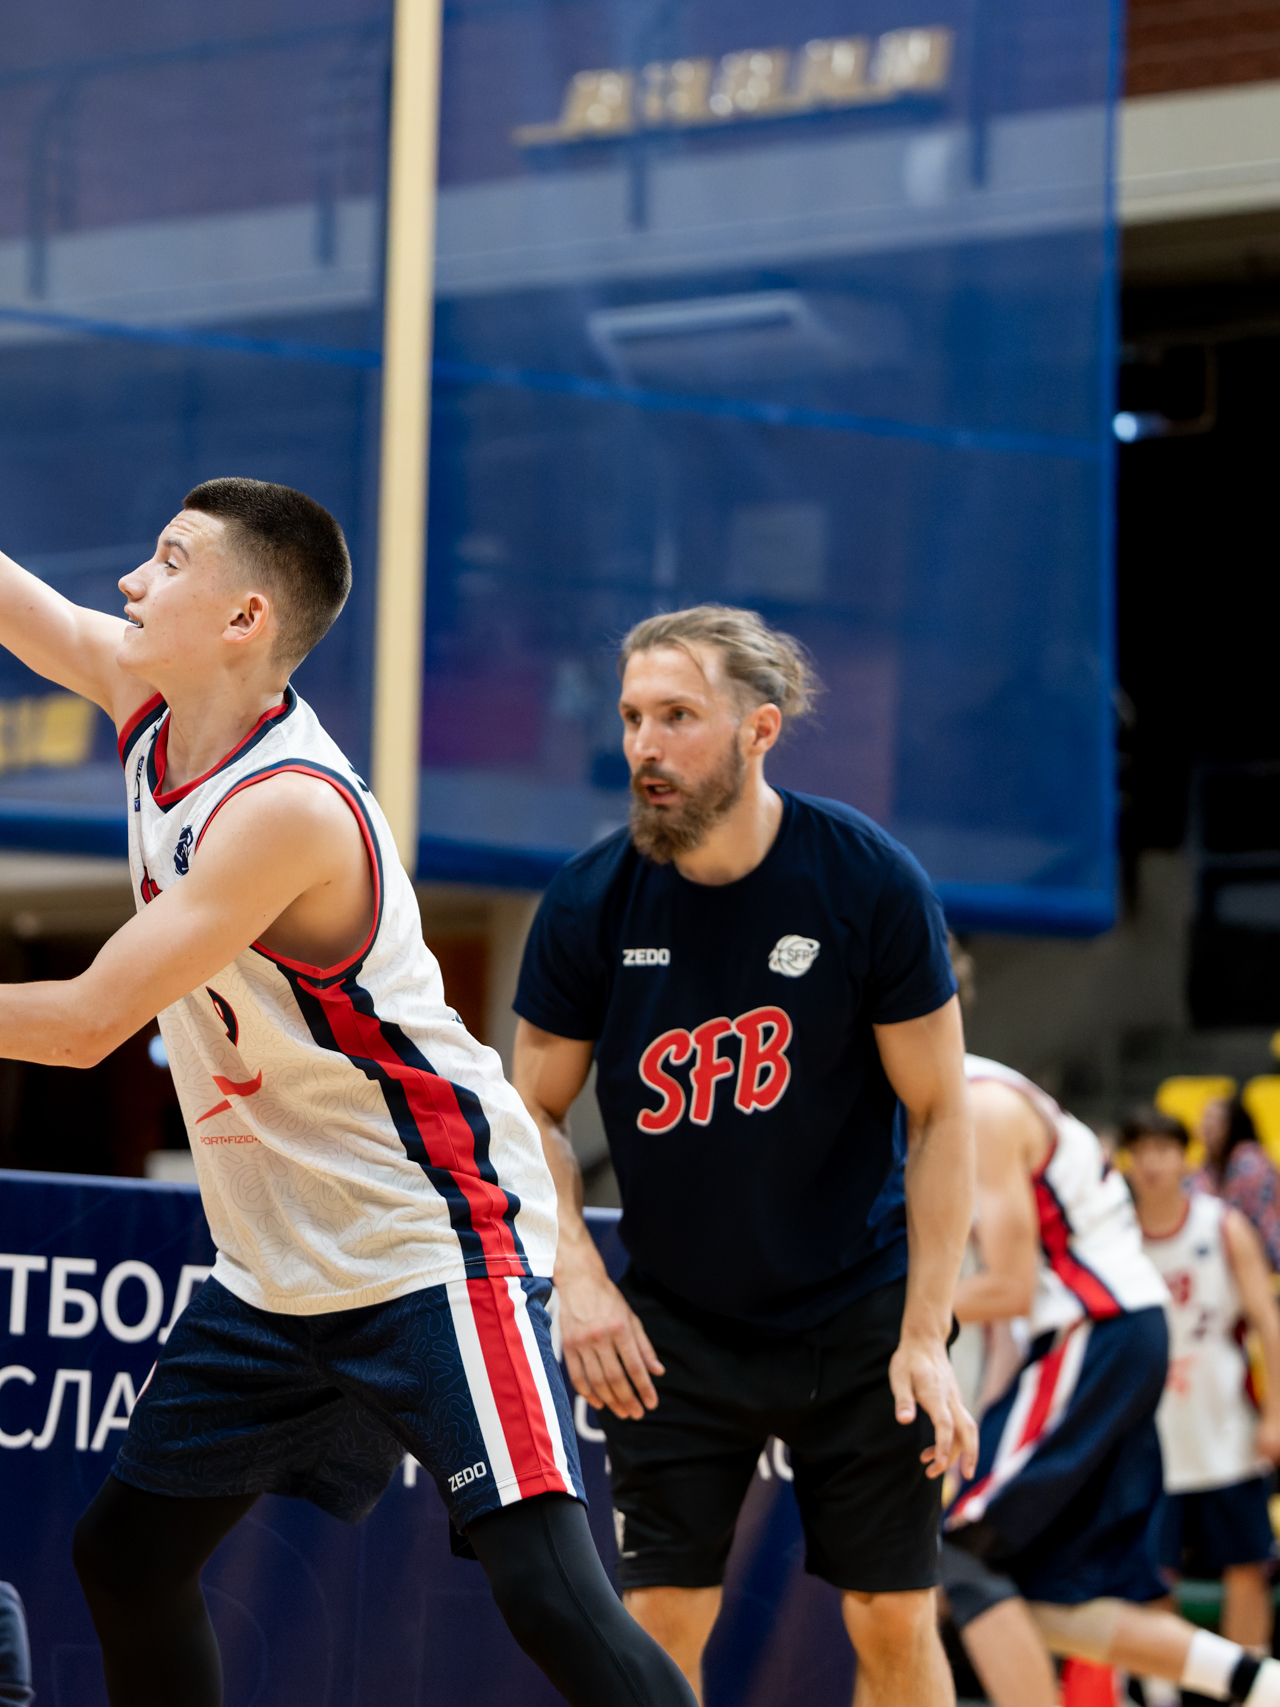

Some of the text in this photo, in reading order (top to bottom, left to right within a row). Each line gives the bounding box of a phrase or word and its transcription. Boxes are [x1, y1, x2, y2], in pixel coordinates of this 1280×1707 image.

[622, 948, 671, 967] ZEDO
[637, 1005, 793, 1135] SFB
[448, 1461, 487, 1493] ZEDO
